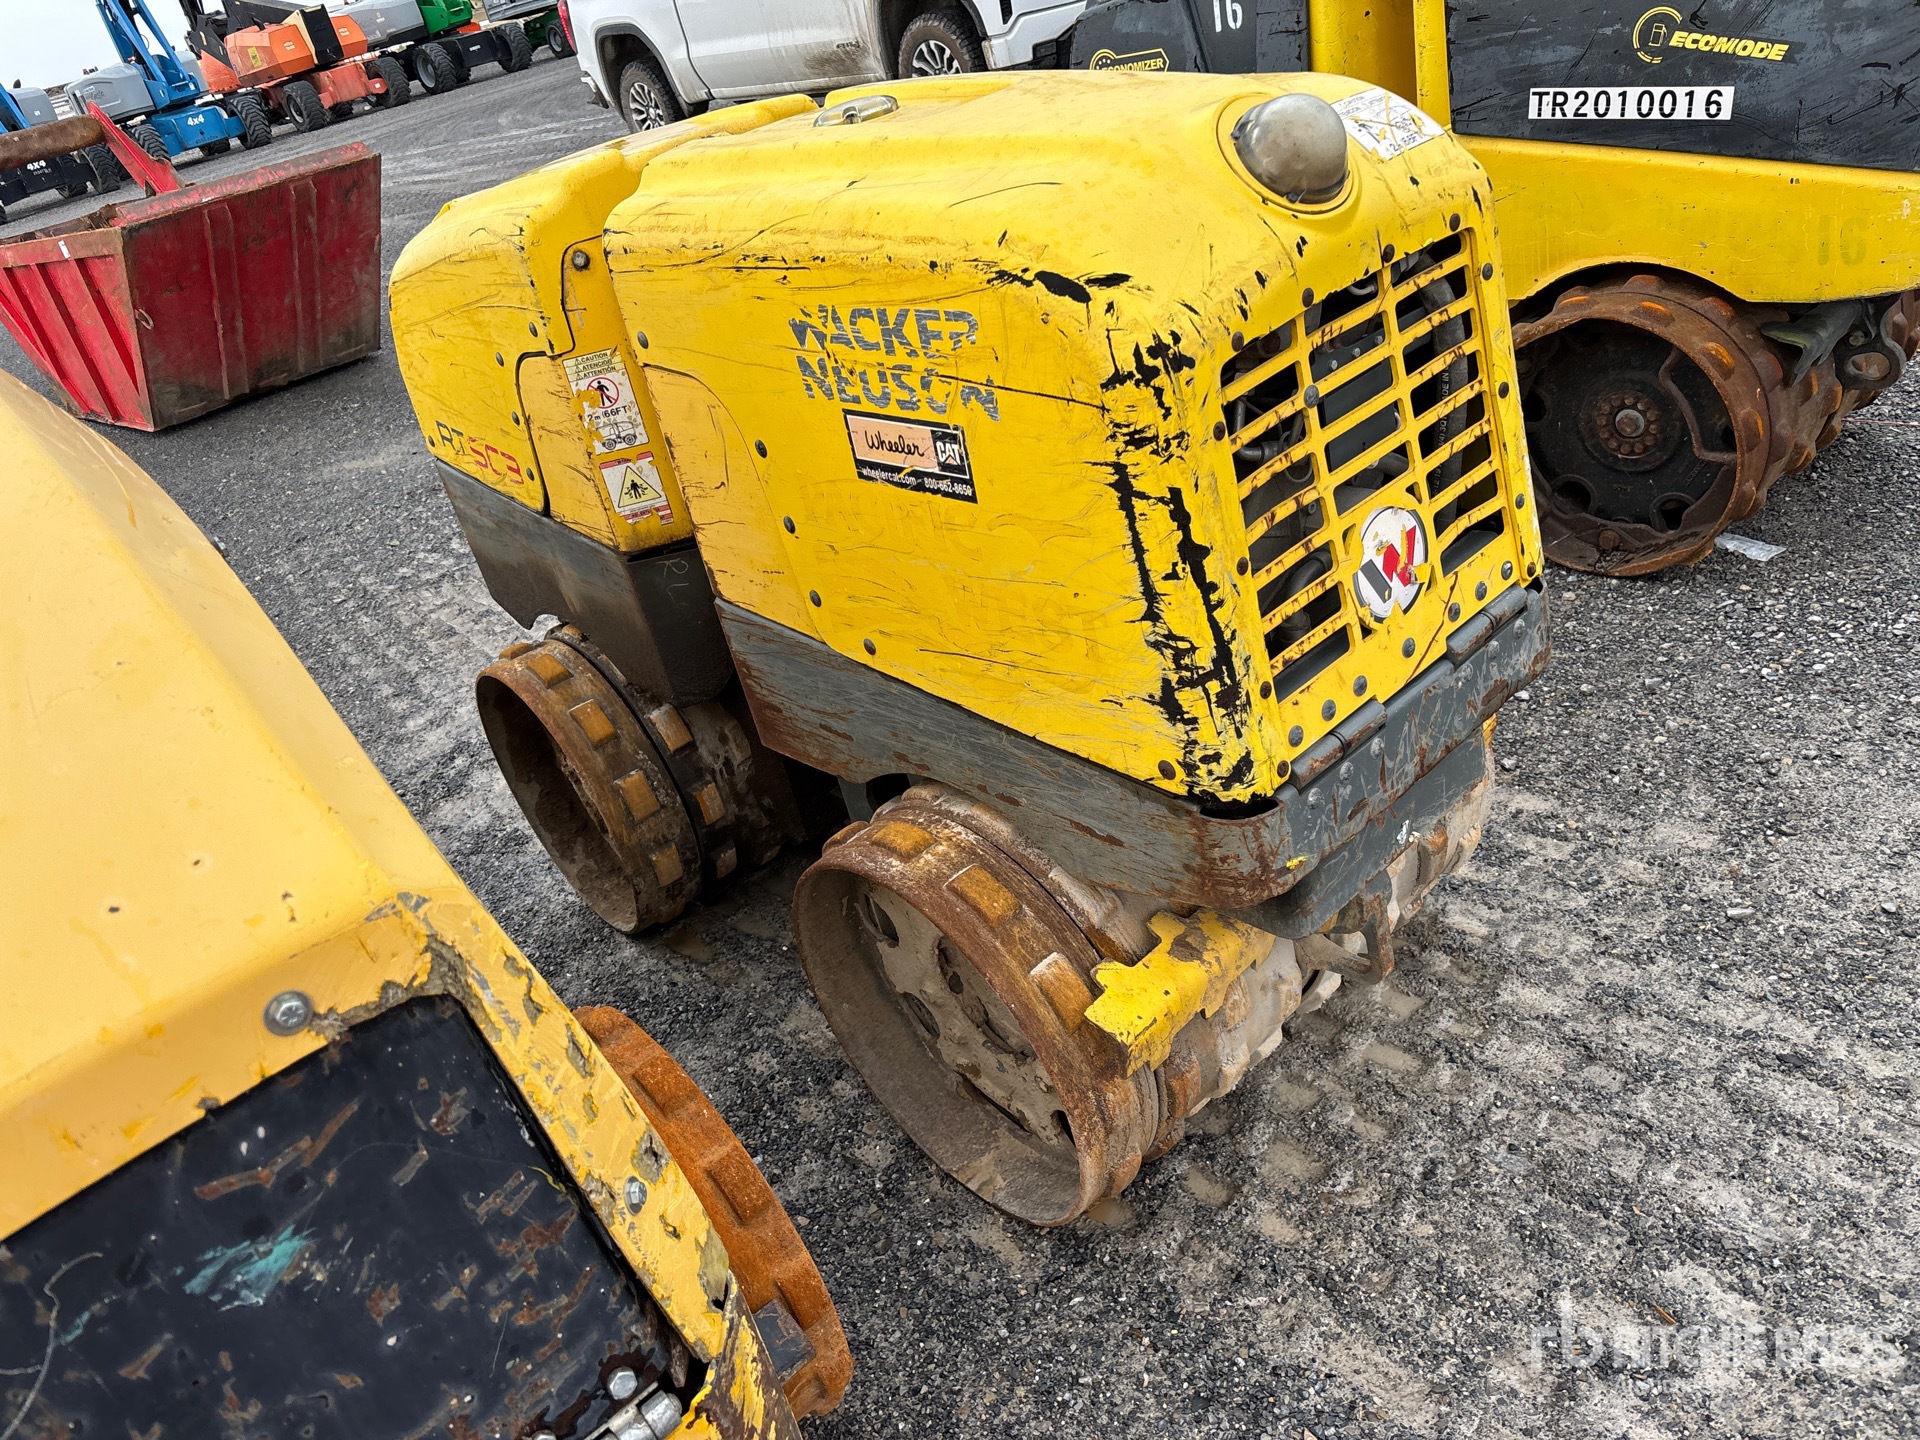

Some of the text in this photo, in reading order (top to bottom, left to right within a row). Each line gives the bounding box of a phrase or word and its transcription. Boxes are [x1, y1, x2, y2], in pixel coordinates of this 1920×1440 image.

[1212, 0, 1243, 33] 16
[1669, 31, 1789, 61] ECOMODE
[1101, 57, 1164, 71] ONOMIZER
[1531, 90, 1723, 118] TR2010016
[788, 304, 979, 360] WACKER
[581, 352, 608, 363] CAUTION
[796, 356, 1000, 422] NEUSON
[864, 430, 961, 466] Wheeler CAT
